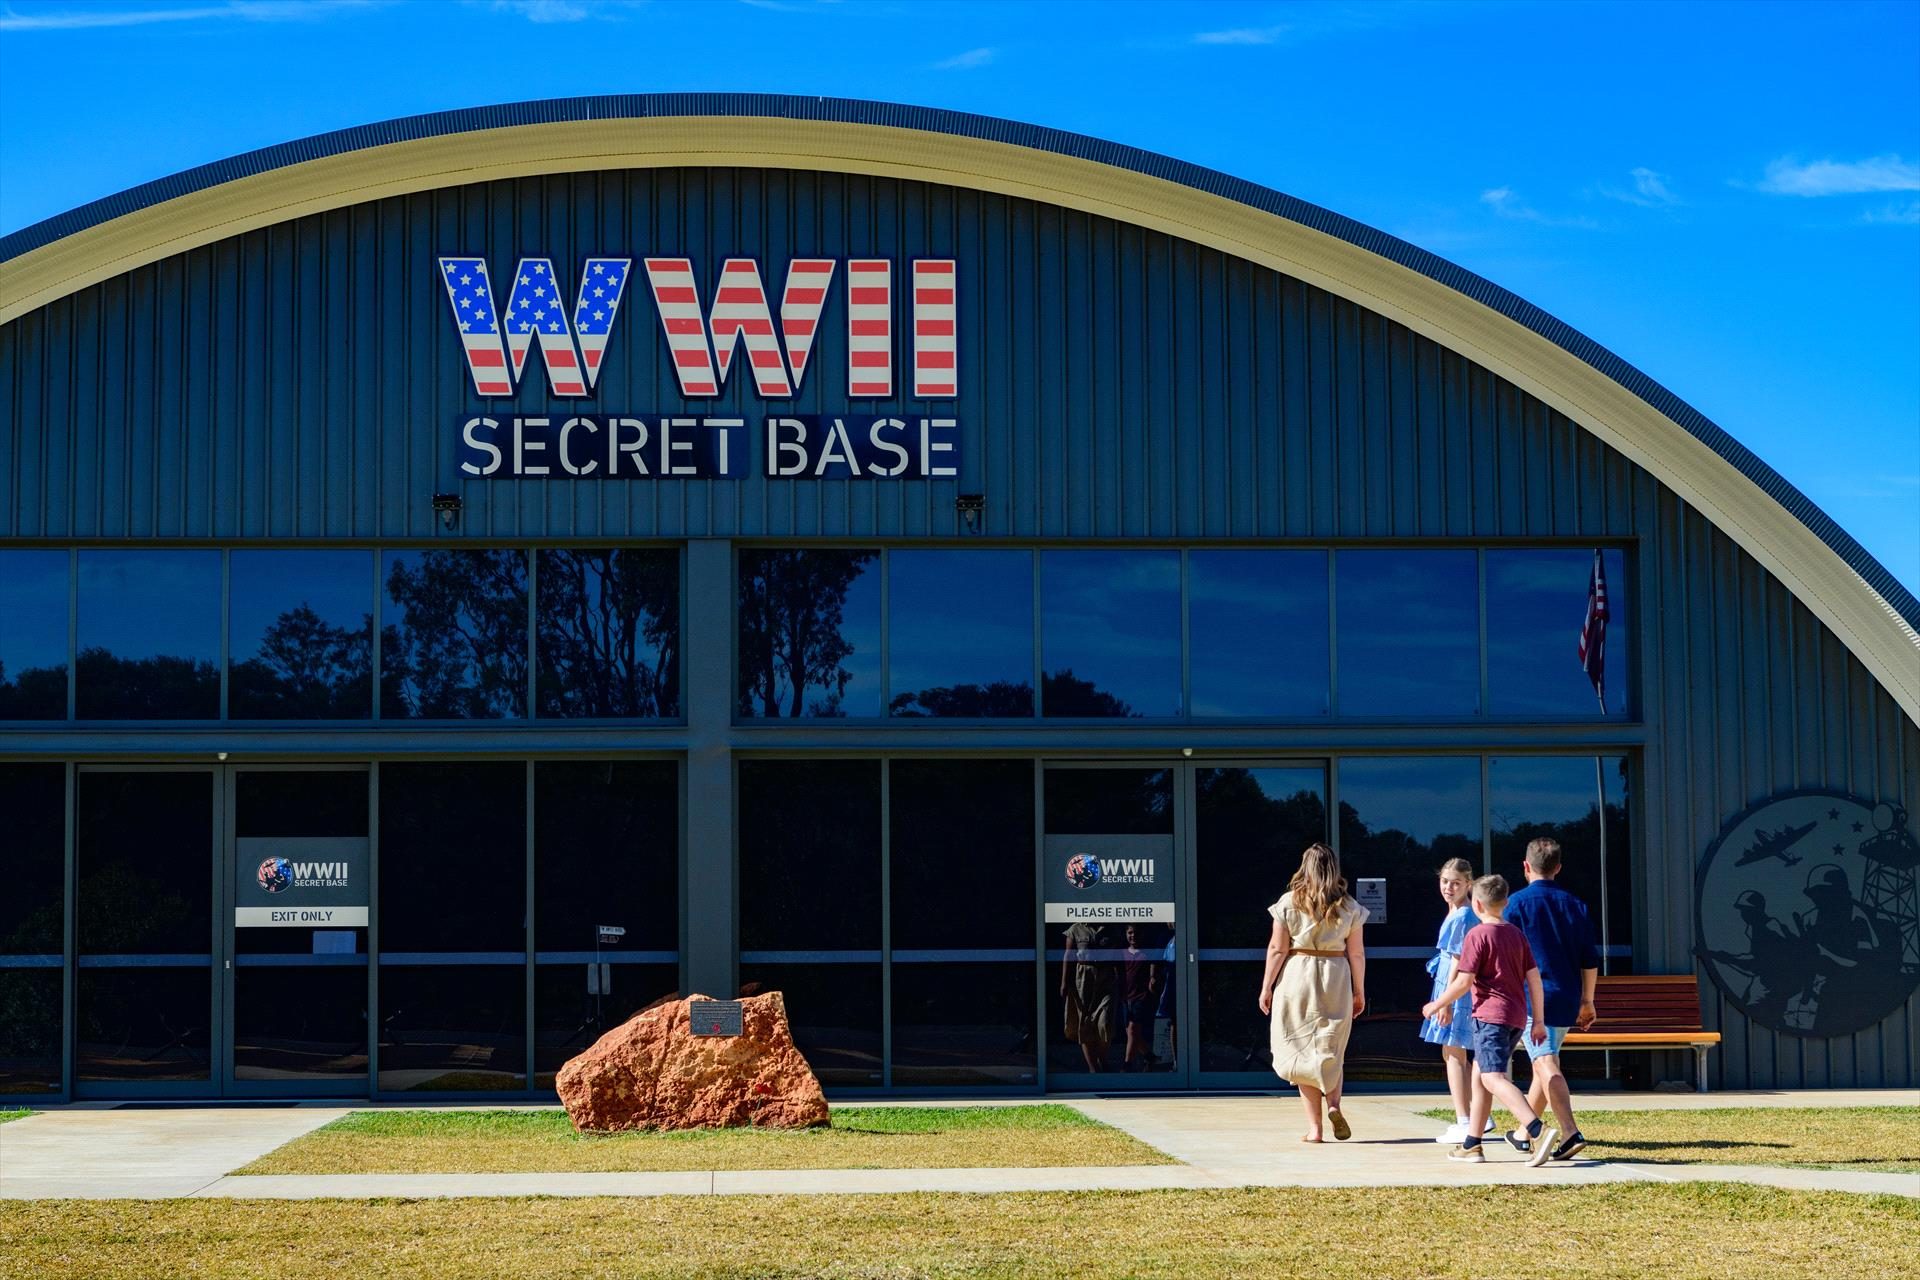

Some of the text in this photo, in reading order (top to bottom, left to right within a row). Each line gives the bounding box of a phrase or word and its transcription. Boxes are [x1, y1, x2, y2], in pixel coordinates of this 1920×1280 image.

[438, 256, 958, 397] WWII
[460, 416, 958, 476] SECRET BASE
[293, 862, 348, 879] WWII
[1100, 859, 1155, 876] WWII
[294, 879, 348, 887] SECRET BASE
[1102, 875, 1155, 883] SECRET BASE
[271, 911, 333, 922] EXIT ONLY
[1066, 907, 1154, 918] PLEASE ENTER
